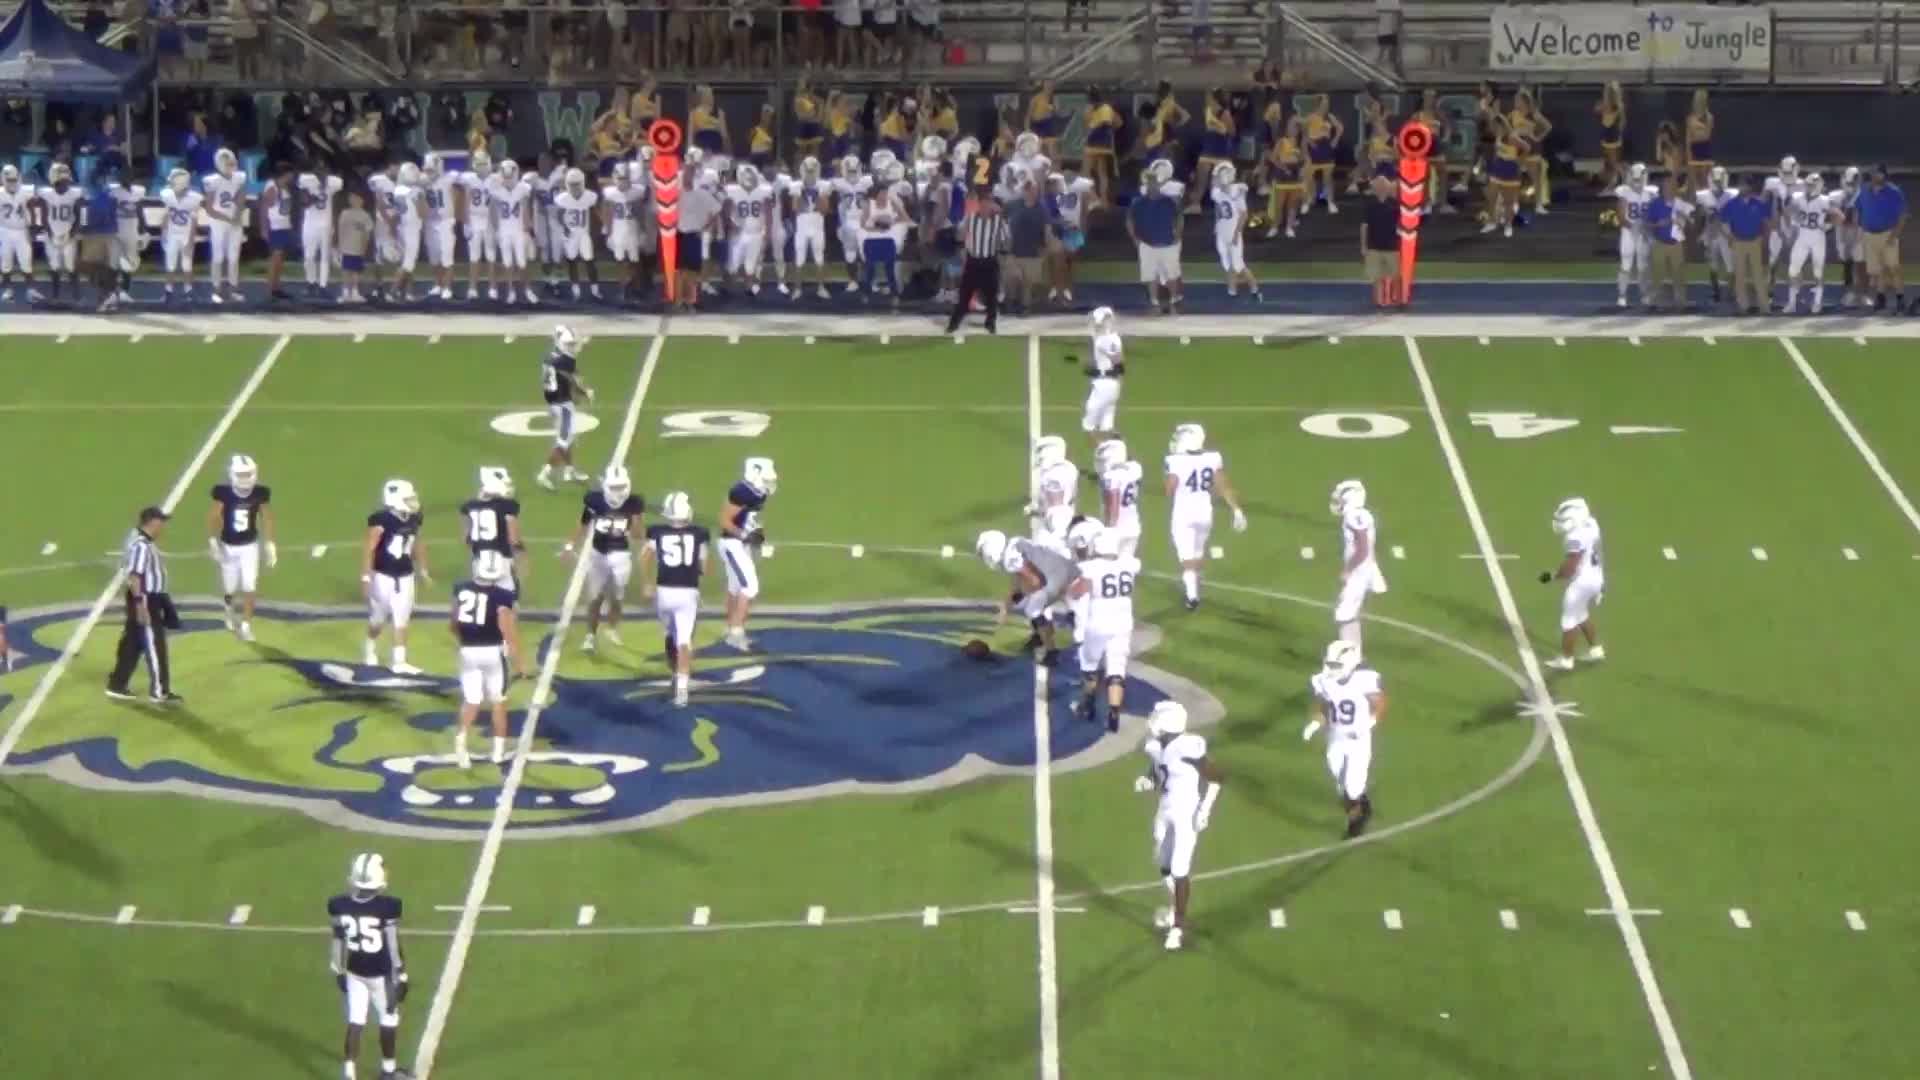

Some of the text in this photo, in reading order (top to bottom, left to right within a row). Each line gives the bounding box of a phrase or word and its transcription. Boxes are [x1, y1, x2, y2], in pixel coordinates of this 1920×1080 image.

[1503, 22, 1641, 56] Welcome
[1648, 11, 1675, 32] to
[1685, 21, 1767, 61] Jungle
[973, 157, 991, 185] 2
[1185, 467, 1214, 493] 48
[233, 509, 249, 532] 5
[470, 508, 498, 542] 19
[661, 534, 695, 567] 51
[1102, 571, 1133, 599] 66
[457, 590, 488, 625] 21
[341, 915, 383, 953] 25
